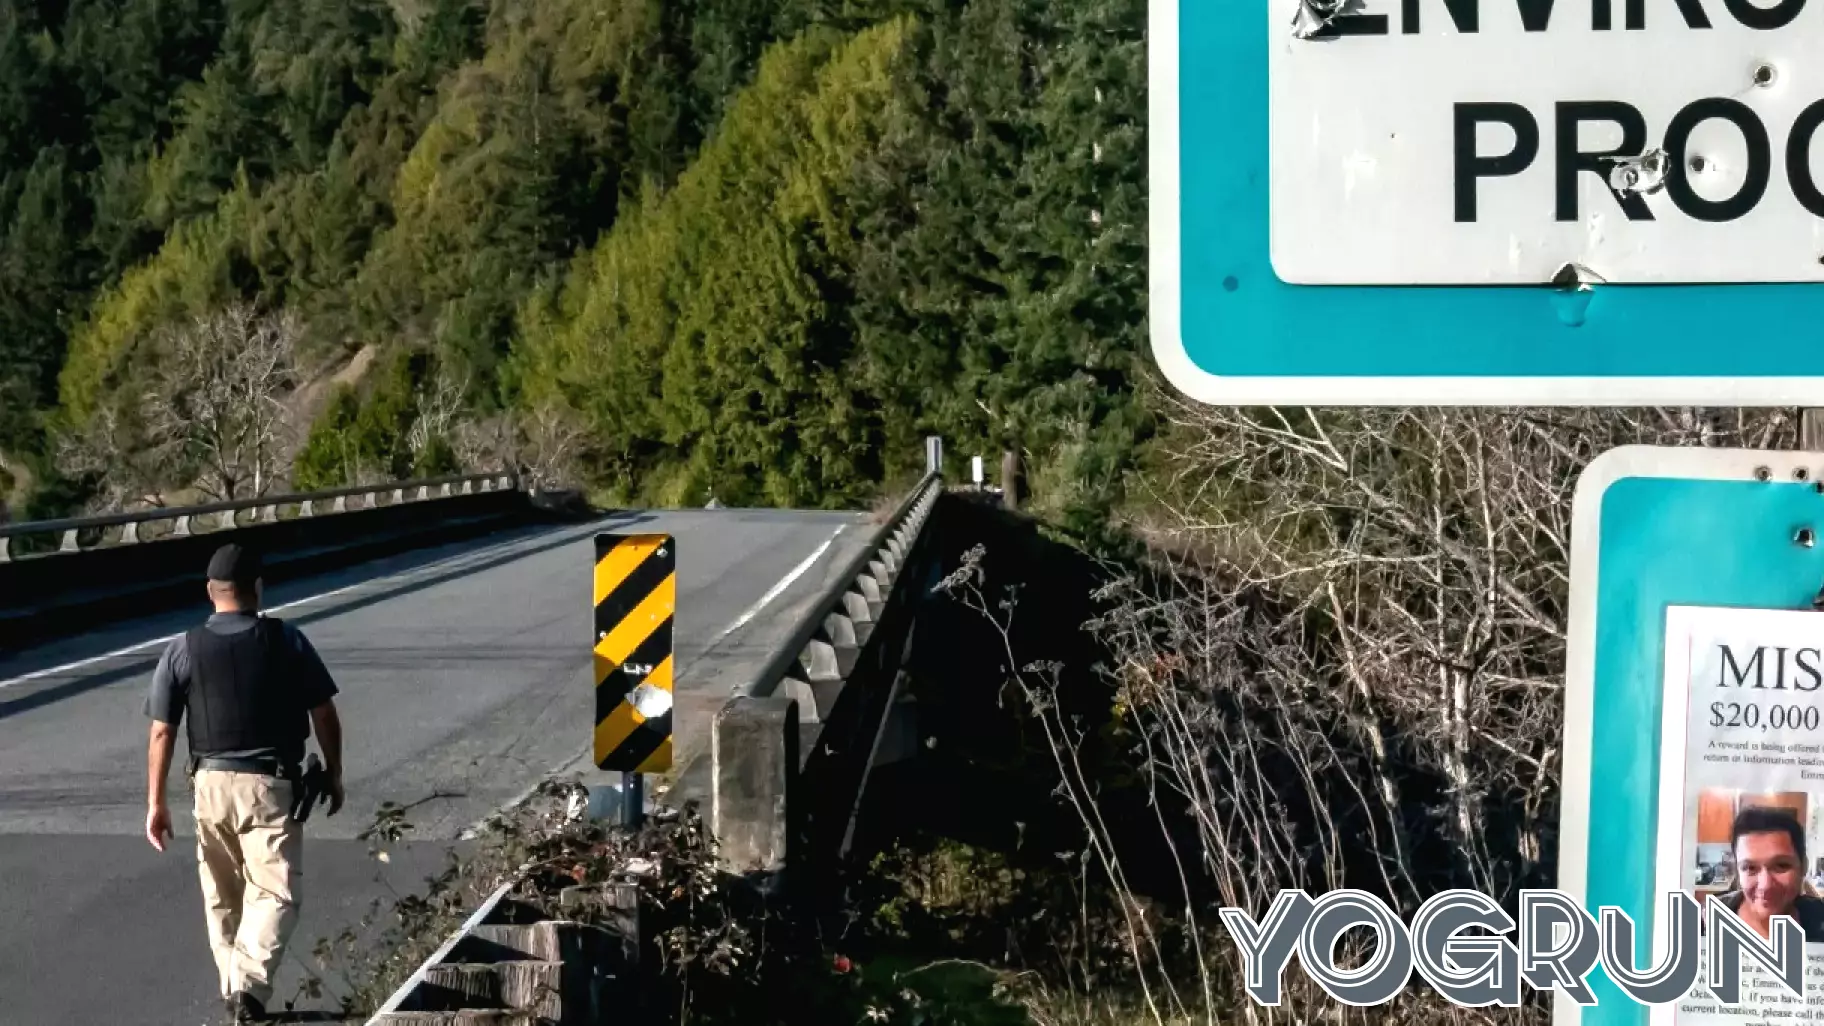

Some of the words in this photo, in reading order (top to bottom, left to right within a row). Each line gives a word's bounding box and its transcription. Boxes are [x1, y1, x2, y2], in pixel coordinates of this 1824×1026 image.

[1716, 644, 1822, 692] MIS
[1709, 701, 1820, 733] $20,000
[1708, 740, 1715, 748] A
[1718, 741, 1749, 750] reward
[1751, 742, 1759, 750] is
[1761, 741, 1786, 753] being
[1787, 743, 1820, 753] offered
[1703, 753, 1730, 763] return
[1744, 754, 1796, 765] information
[1760, 994, 1778, 1004] you
[1681, 1004, 1716, 1014] current
[1762, 1007, 1793, 1018] please
[1795, 1009, 1813, 1019] call
